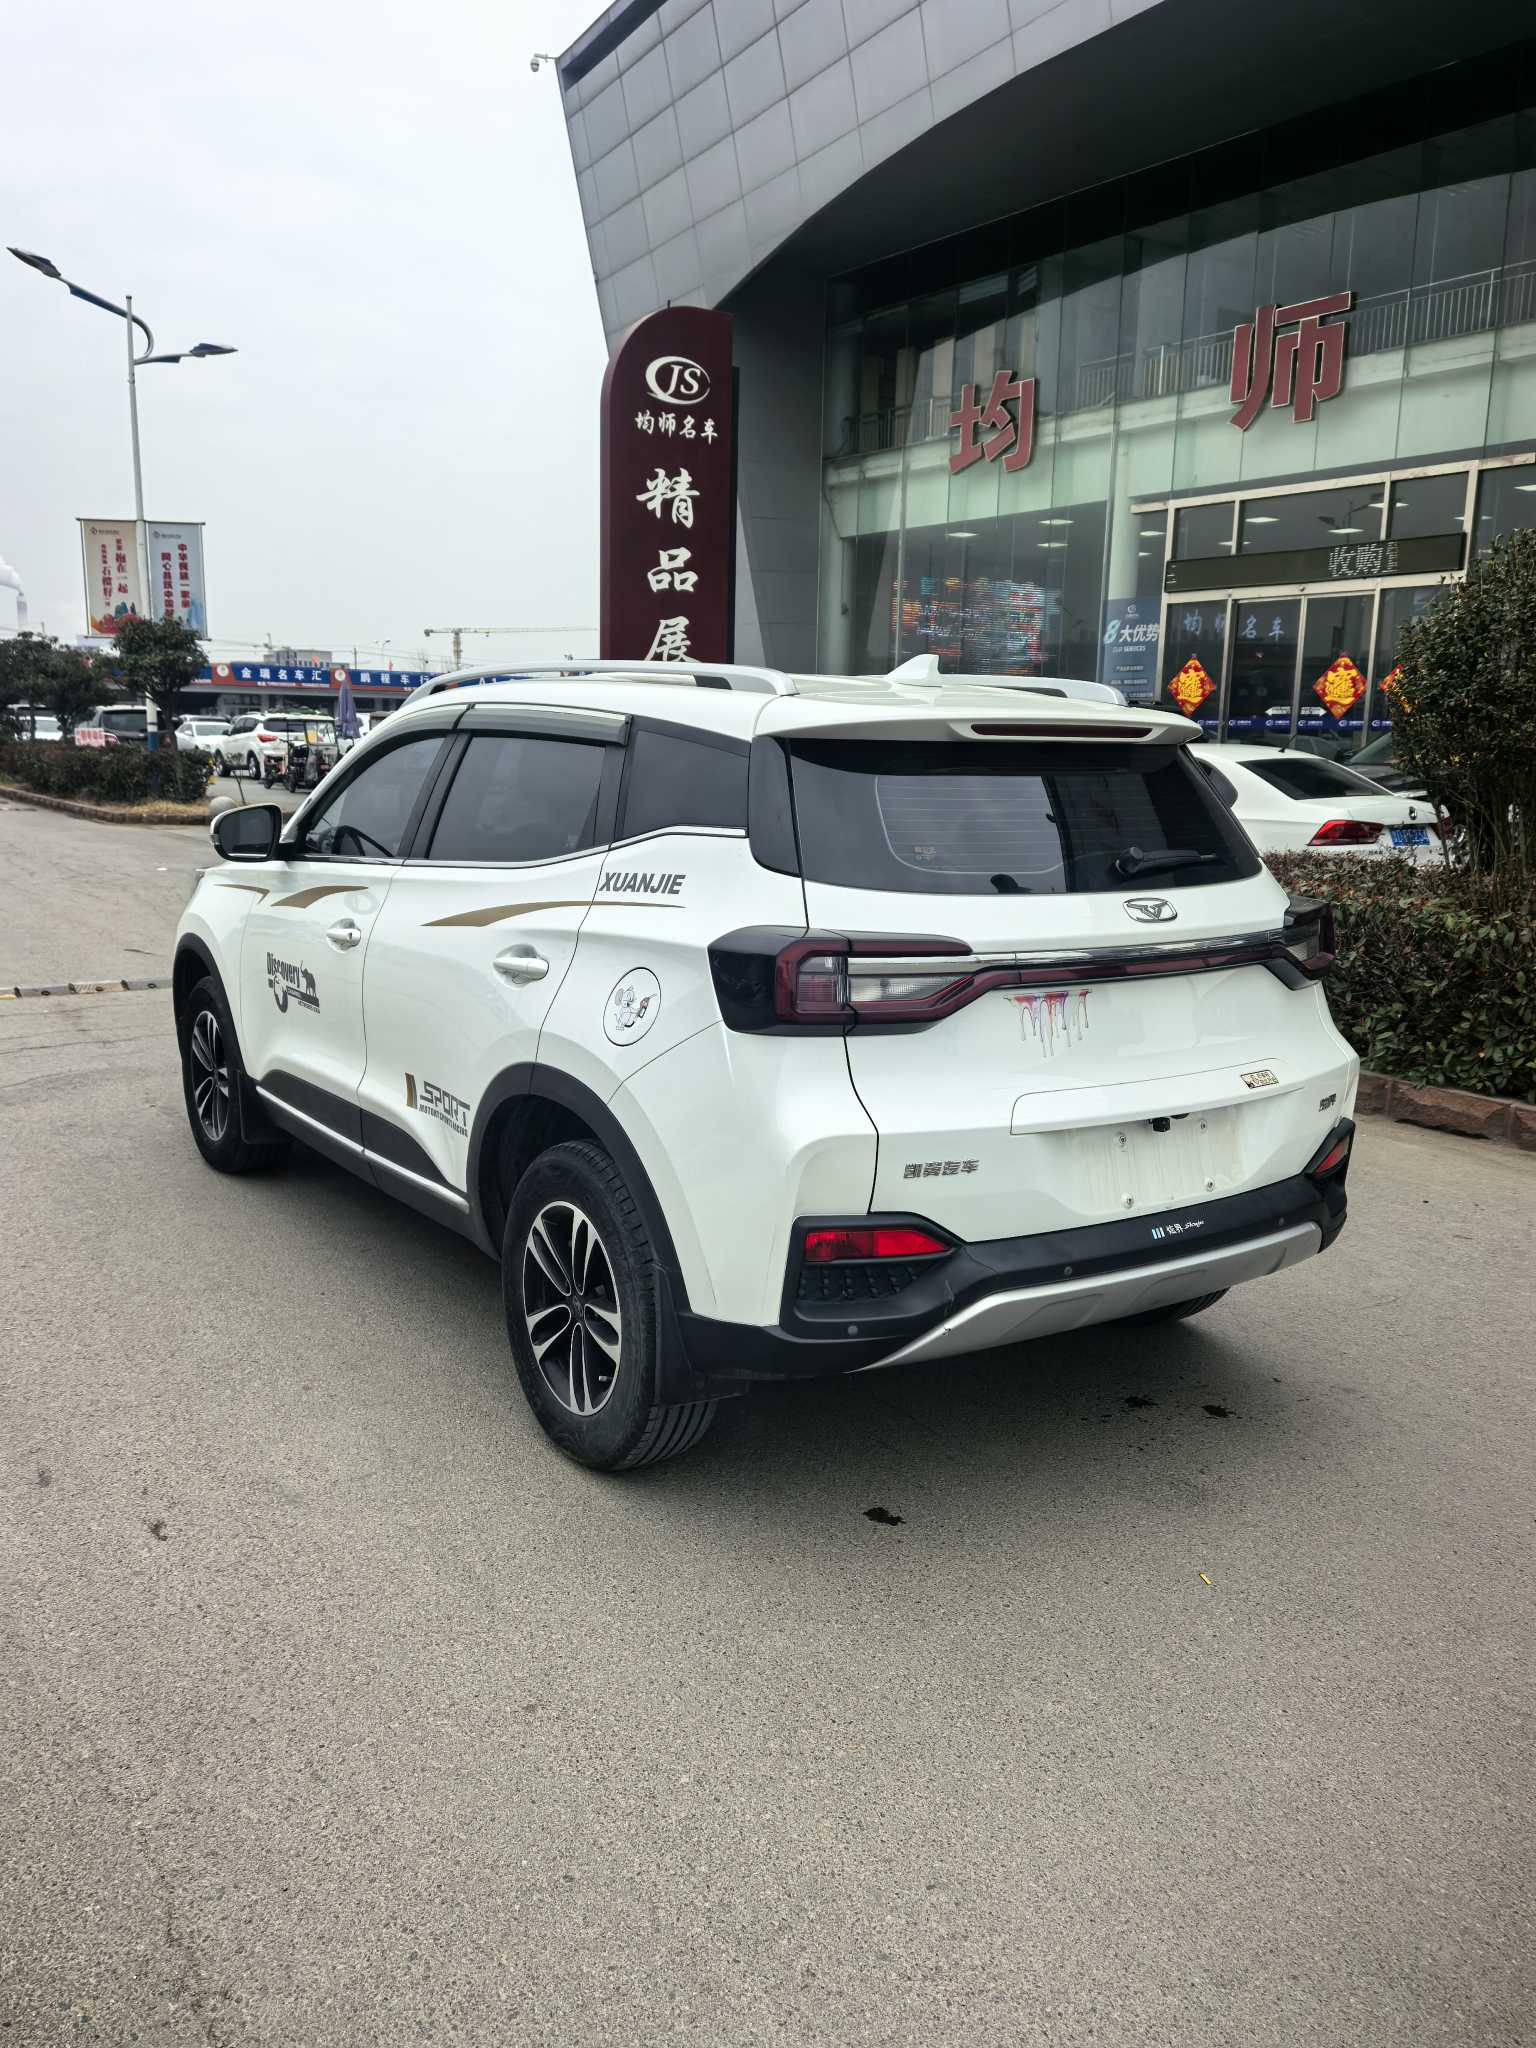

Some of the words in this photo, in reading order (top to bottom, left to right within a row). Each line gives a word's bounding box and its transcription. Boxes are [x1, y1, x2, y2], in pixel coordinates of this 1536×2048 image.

[634, 408, 719, 446] 均师名车
[635, 466, 703, 664] 精品展
[598, 872, 687, 895] XUANJIE
[266, 951, 301, 990] Discovery
[419, 1080, 471, 1127] SPORT
